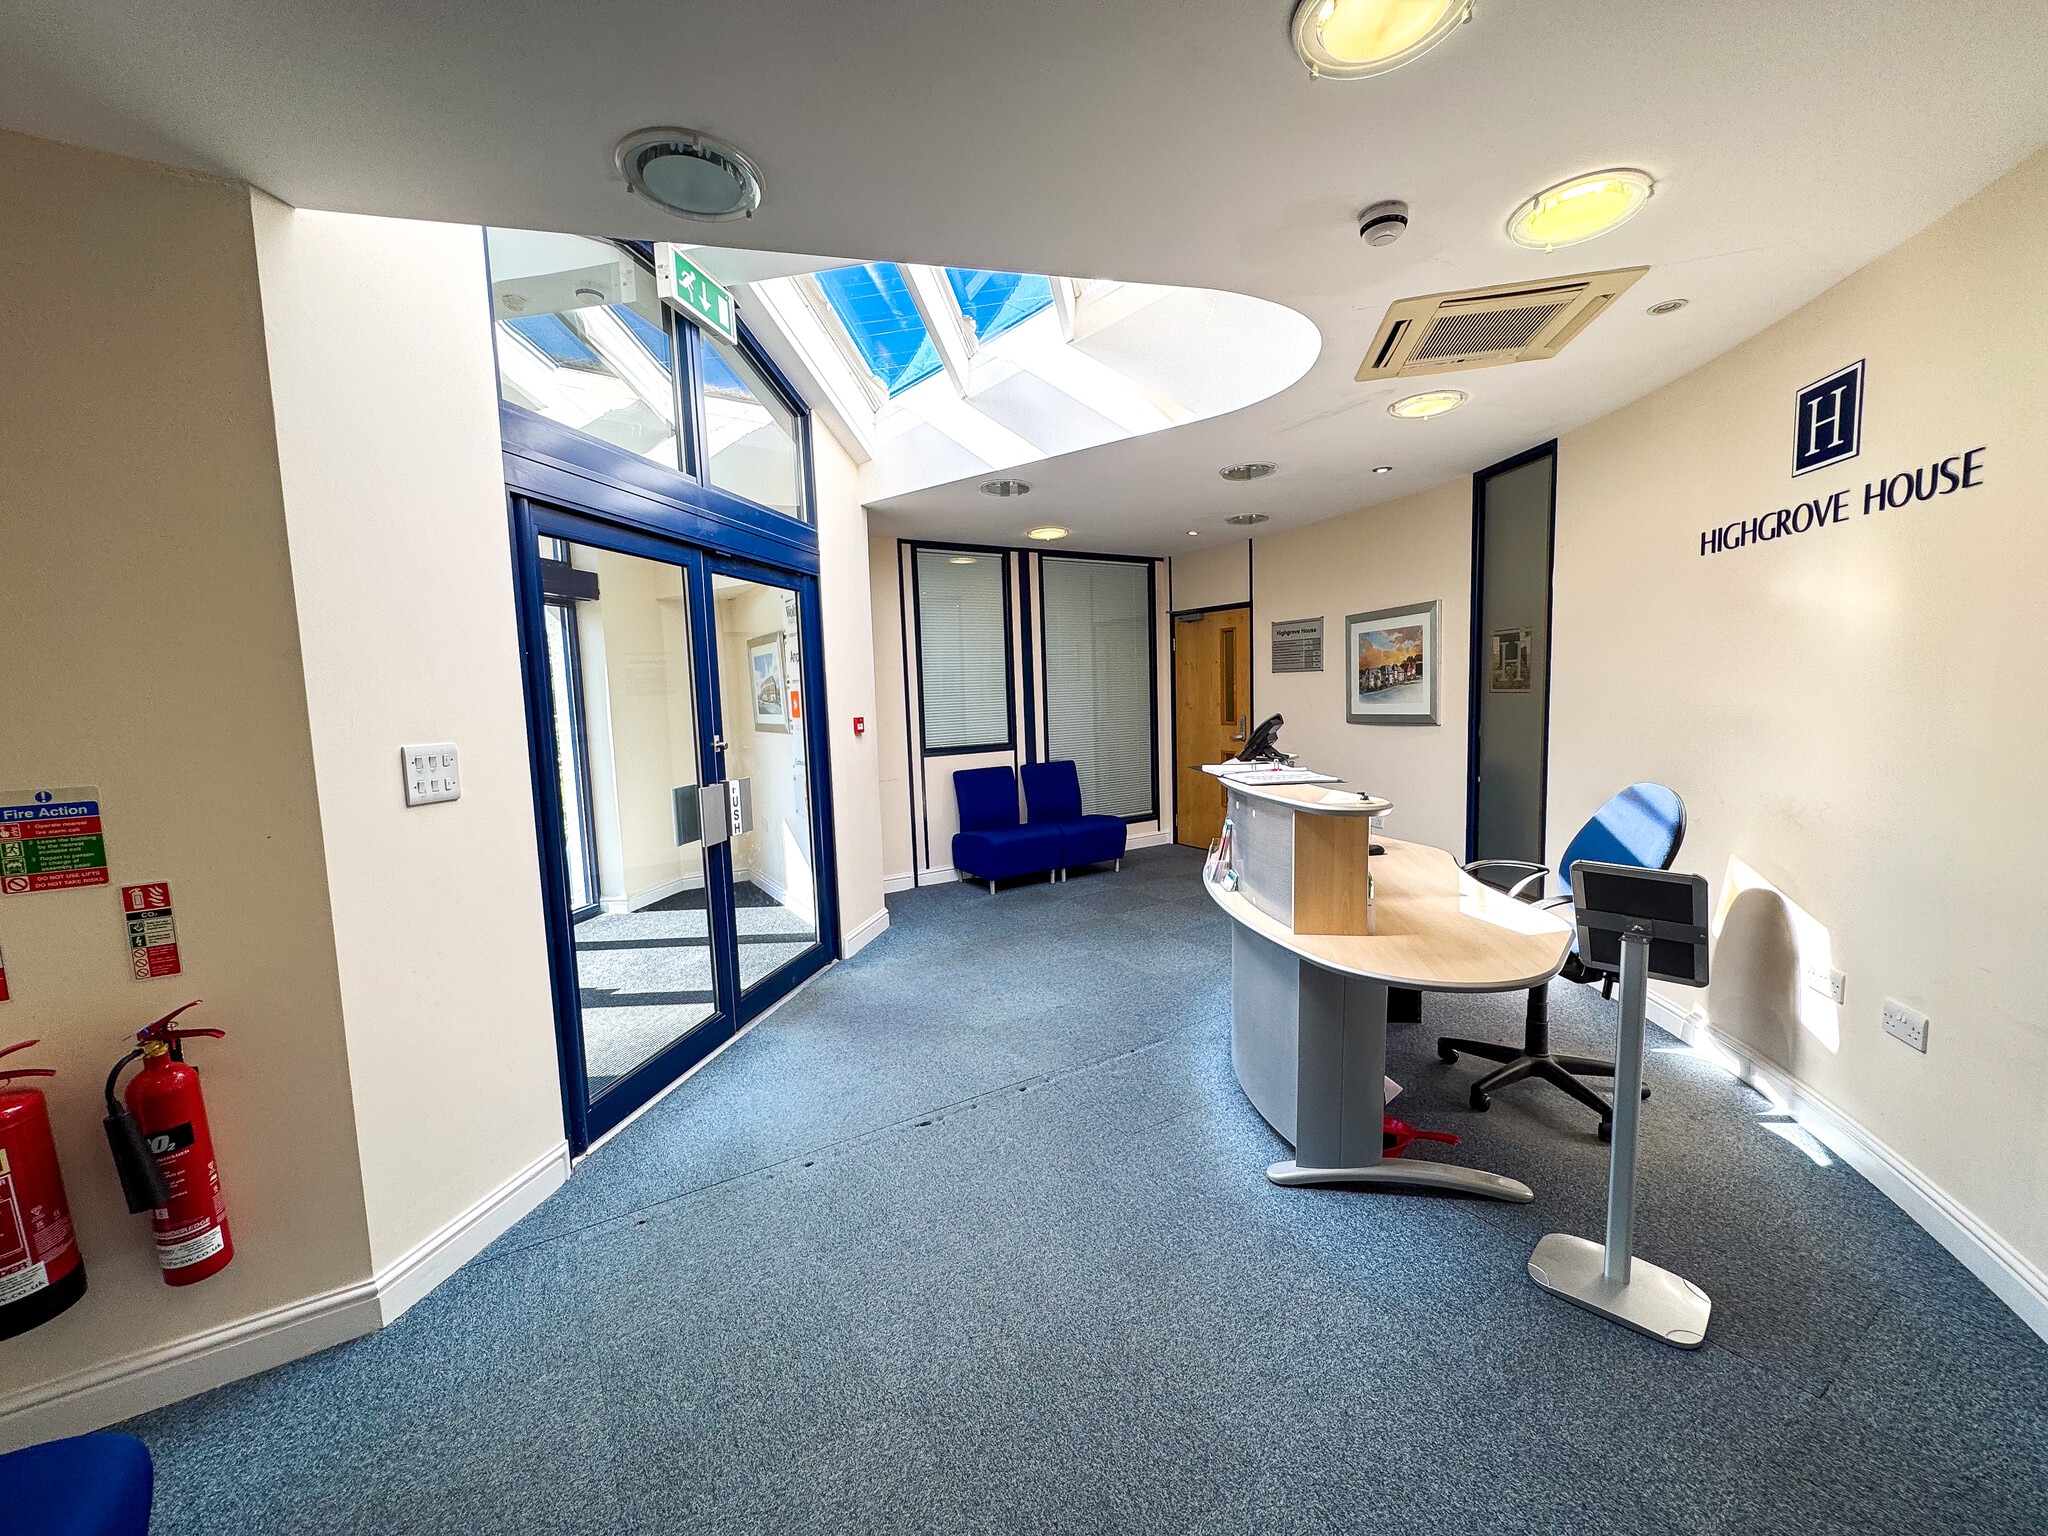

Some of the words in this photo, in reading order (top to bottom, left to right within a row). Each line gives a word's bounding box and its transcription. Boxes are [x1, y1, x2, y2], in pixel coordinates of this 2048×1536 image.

[1804, 385, 1847, 457] H
[1700, 489, 1851, 556] HIGHGROVE
[1863, 447, 1987, 515] HOUSE
[1277, 629, 1300, 637] Highgrove
[3, 809, 34, 819] Fire
[38, 806, 88, 816] Action
[147, 1135, 176, 1153] O2
